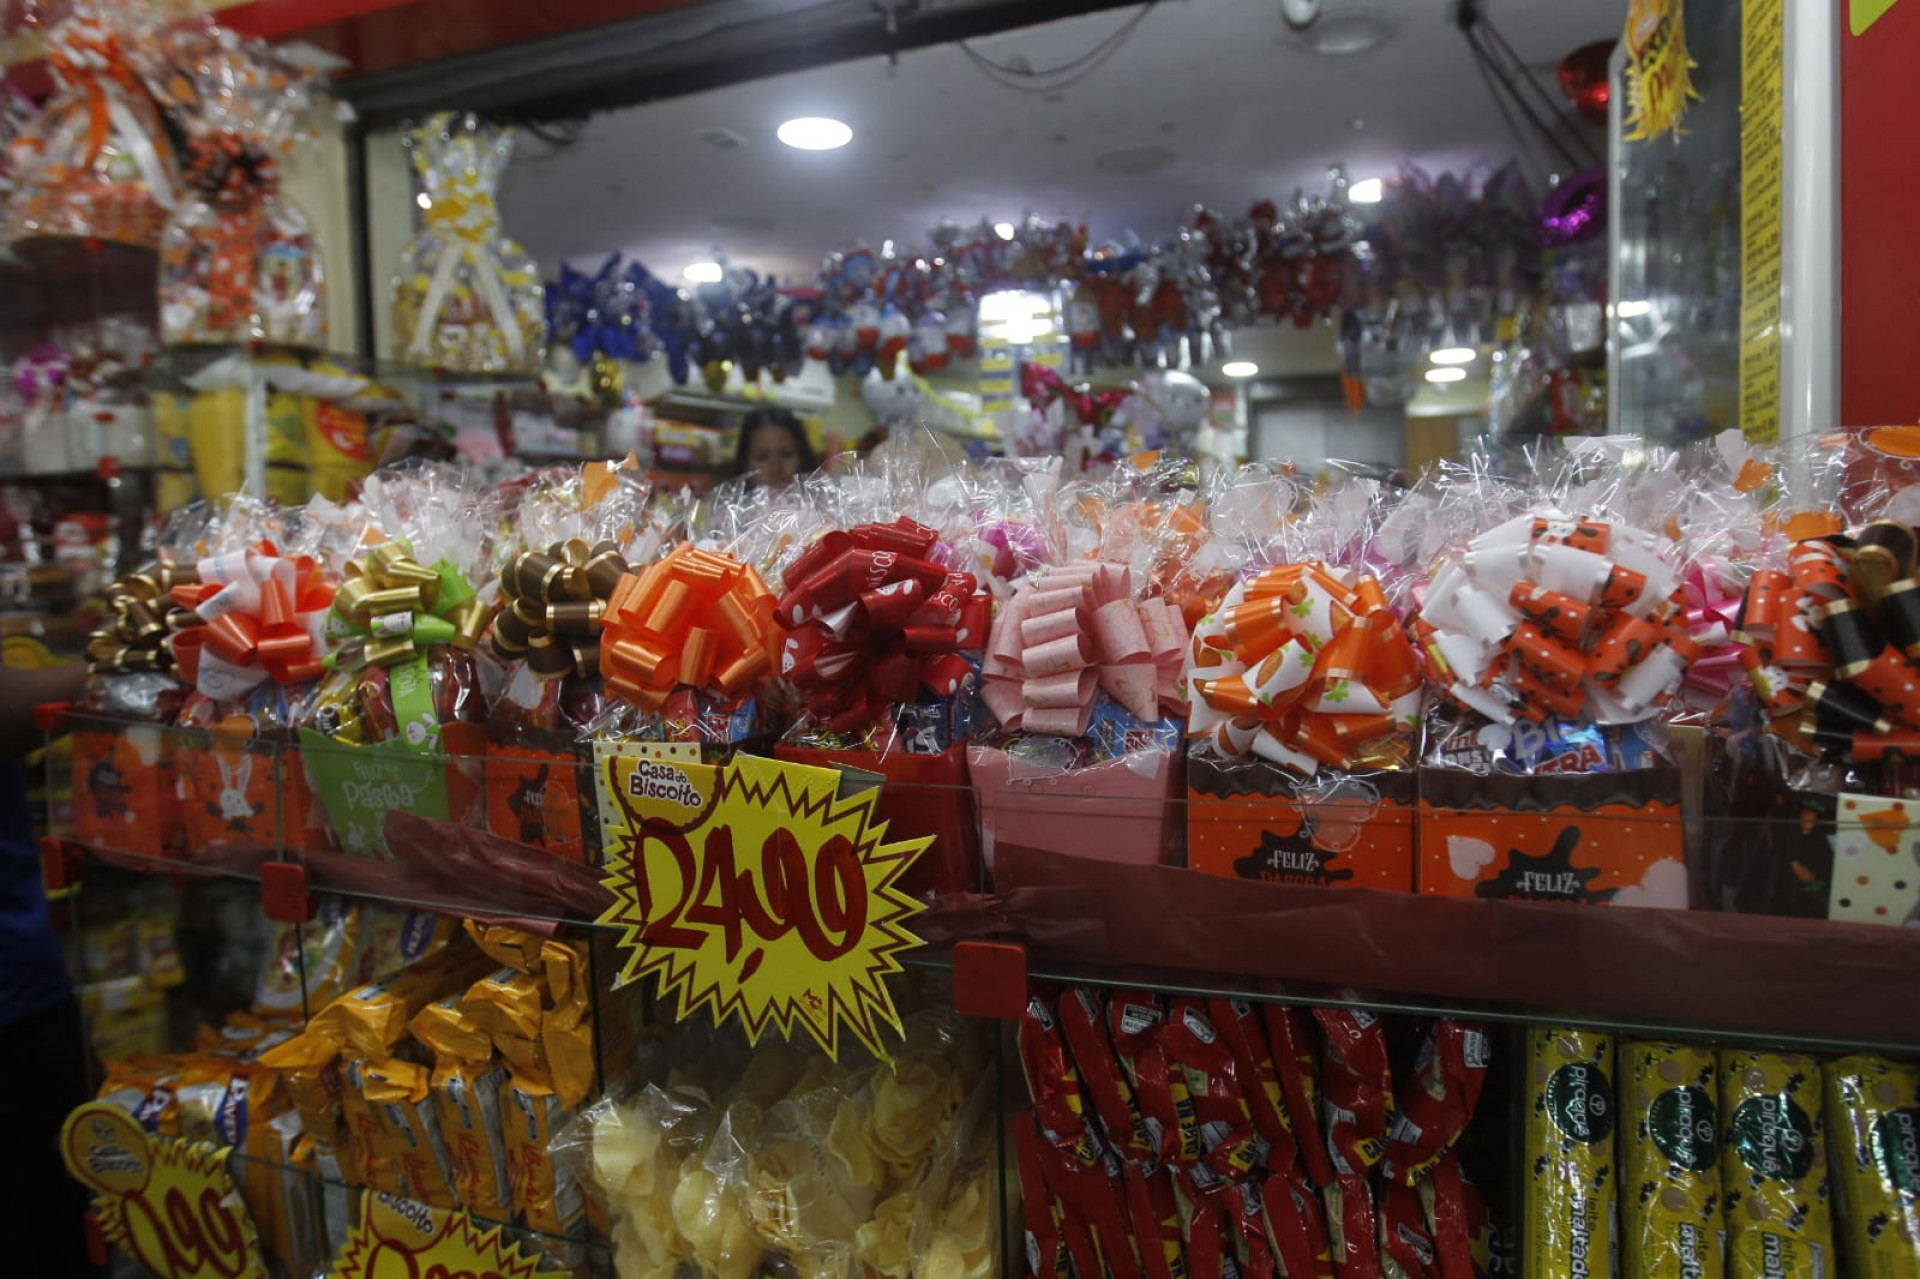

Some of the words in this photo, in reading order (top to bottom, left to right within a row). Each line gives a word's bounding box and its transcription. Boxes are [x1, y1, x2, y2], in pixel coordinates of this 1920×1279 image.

[638, 759, 674, 781] Casa
[675, 772, 687, 783] do
[630, 774, 702, 807] Biscoito
[1272, 849, 1316, 872] FELIZ
[1523, 871, 1575, 894] FELIZ
[1570, 1065, 1590, 1137] piraquê
[1676, 1089, 1697, 1168] piraquê
[1761, 1097, 1782, 1173] piraquê
